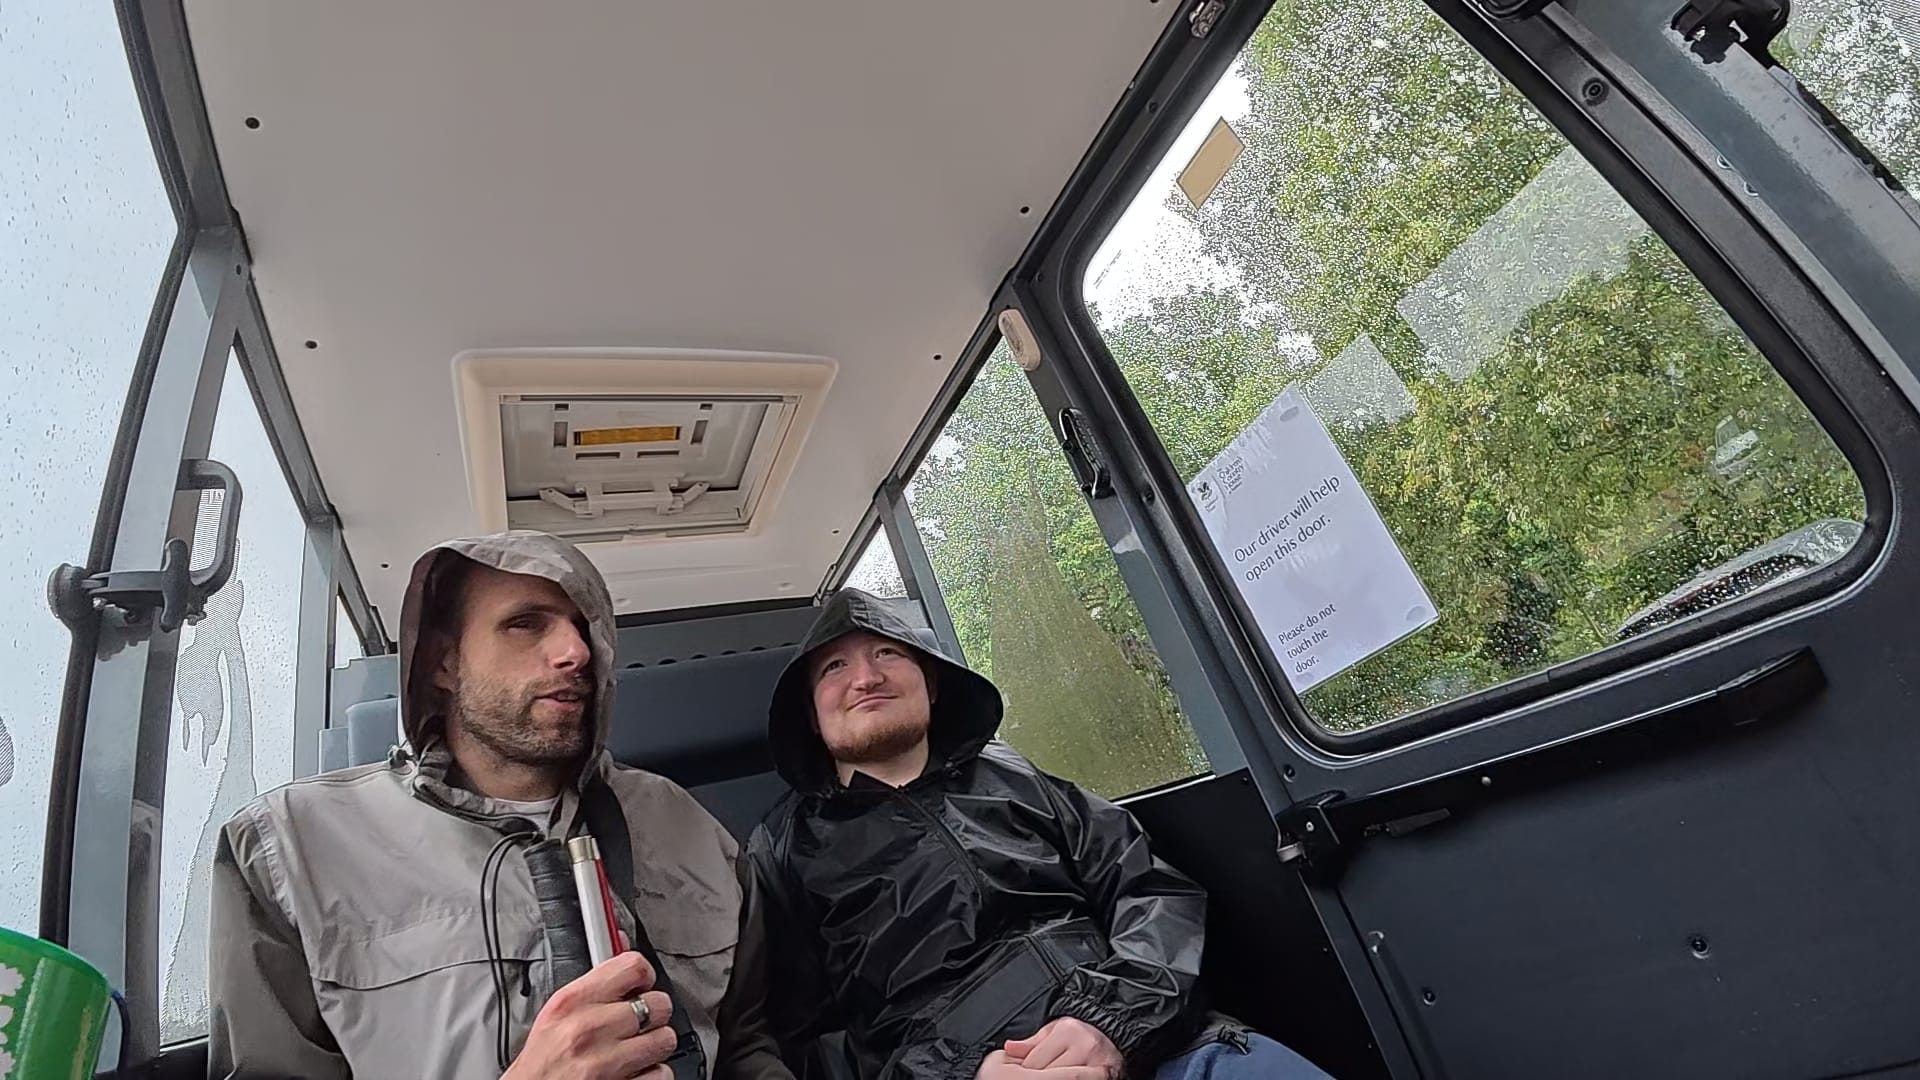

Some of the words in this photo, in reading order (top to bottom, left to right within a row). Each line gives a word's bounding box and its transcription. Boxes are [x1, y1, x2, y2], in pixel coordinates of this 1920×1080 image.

[1234, 541, 1256, 562] Our
[1258, 515, 1290, 545] driver
[1290, 495, 1312, 519] will
[1309, 476, 1340, 503] help
[1246, 556, 1275, 581] open
[1274, 539, 1297, 560] this
[1298, 514, 1331, 542] door.
[1278, 624, 1306, 645] Please
[1306, 616, 1319, 628] do
[1319, 604, 1336, 620] not
[1287, 638, 1313, 658] touch
[1312, 629, 1328, 644] the
[1296, 656, 1319, 673] door.
